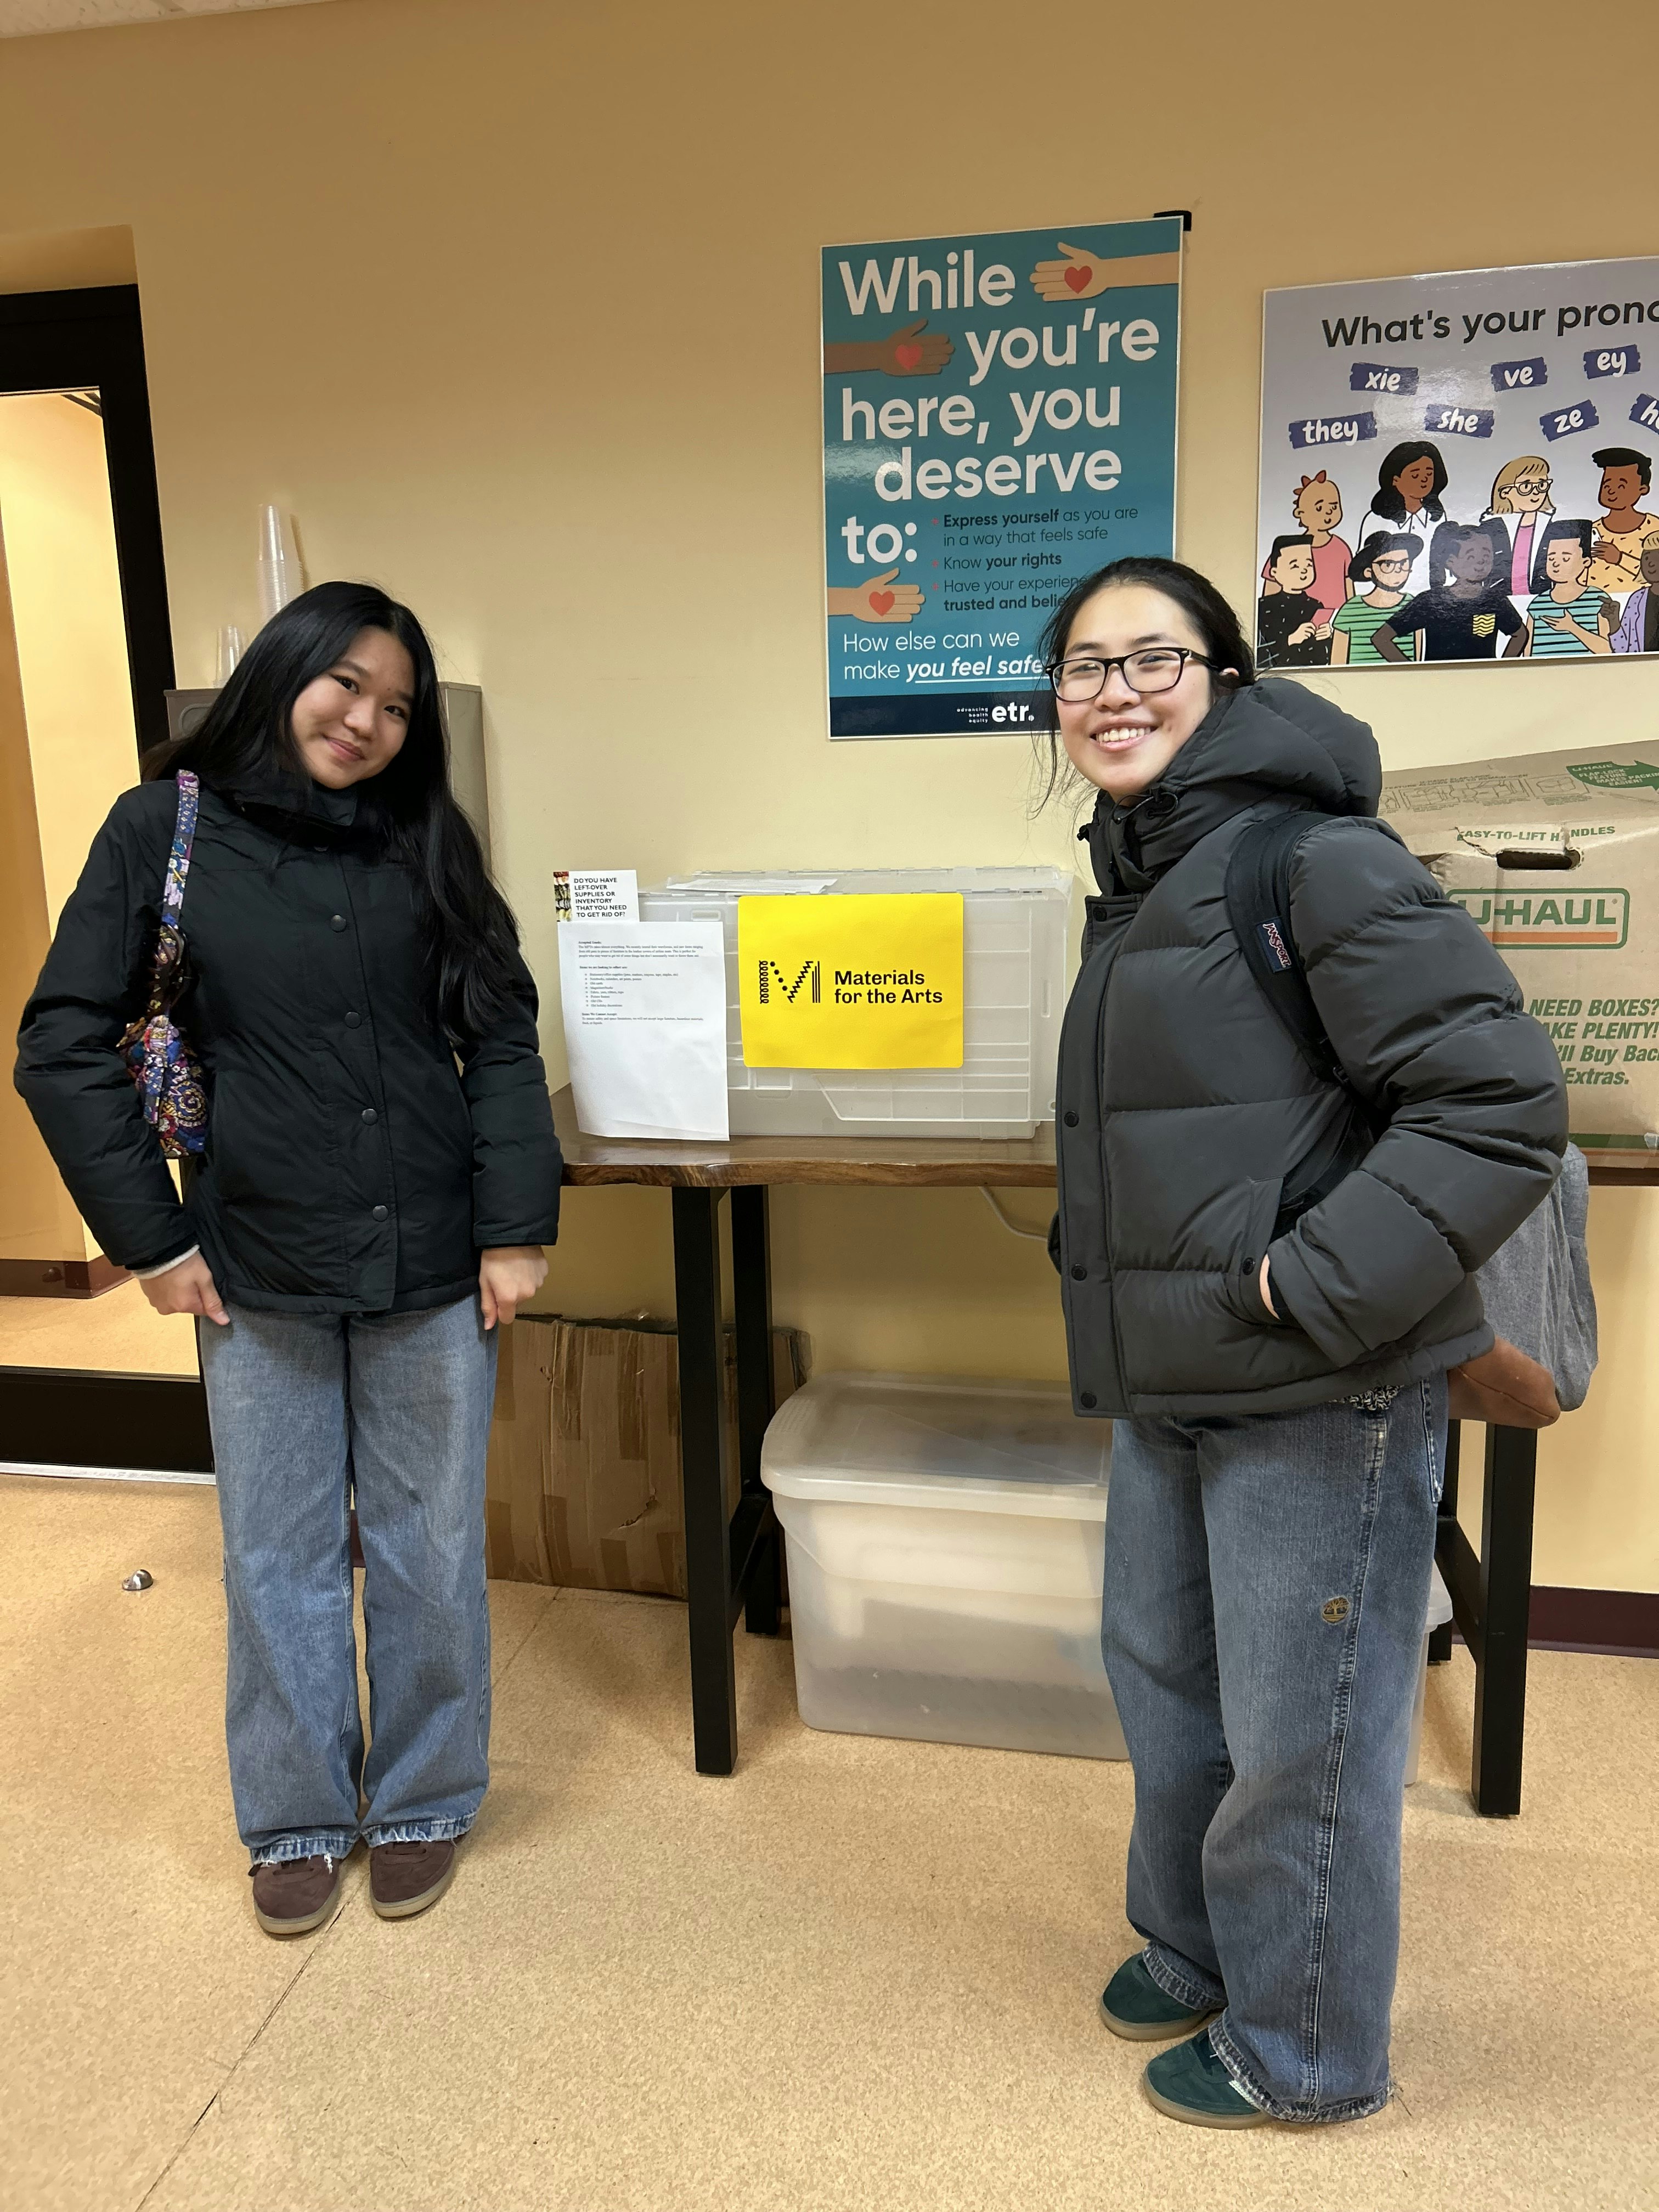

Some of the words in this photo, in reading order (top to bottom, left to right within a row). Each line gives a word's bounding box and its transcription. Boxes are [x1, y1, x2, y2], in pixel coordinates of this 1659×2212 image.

[838, 250, 1015, 315] While
[1322, 311, 1451, 347] What's
[1462, 308, 1545, 344] your
[1557, 301, 1659, 336] prono
[965, 308, 1159, 386] you're
[1597, 350, 1627, 377] ey
[1365, 368, 1400, 391] xie
[1504, 365, 1534, 387] ve
[842, 388, 990, 444] here,
[1009, 386, 1120, 447] you
[1437, 408, 1479, 433] she
[1554, 407, 1584, 433] ze
[1303, 420, 1358, 446] they
[875, 447, 1121, 501] deserve
[944, 514, 998, 530] Express
[1002, 509, 1059, 527] yourself
[1063, 511, 1080, 521] as
[1084, 510, 1110, 524] you
[1114, 508, 1138, 519] are
[841, 516, 917, 563] to:
[944, 534, 955, 546] in
[959, 537, 969, 546] a
[973, 534, 1002, 548] way
[1006, 530, 1036, 544] that
[1040, 528, 1073, 542] feels
[1077, 528, 1108, 541] safe
[944, 557, 981, 569] Know
[986, 556, 1018, 571] your
[1021, 552, 1062, 571] rights
[944, 579, 980, 593] Have
[984, 578, 1014, 595] your
[944, 597, 995, 611] trusted
[999, 595, 1026, 608] and
[1032, 593, 1066, 608] belie
[844, 633, 889, 652] How
[896, 630, 935, 650] else
[943, 634, 982, 648] can
[989, 631, 1019, 647] we
[844, 659, 900, 680] make
[906, 660, 944, 682] you
[952, 656, 992, 676] feel
[997, 654, 1042, 675] safe
[1550, 826, 1616, 842] HNDLES
[834, 970, 925, 985] Materials
[834, 989, 862, 1003] for
[866, 989, 896, 1004] the
[901, 989, 943, 1004] Arts
[1529, 999, 1583, 1016] NEED
[1587, 998, 1659, 1017] BOXES?
[1543, 1022, 1578, 1039] AKE
[1582, 1022, 1659, 1040] PLENTY!
[1580, 1045, 1618, 1066] Buy
[1623, 1045, 1659, 1062] Bac
[1565, 1067, 1629, 1085] Extras.
